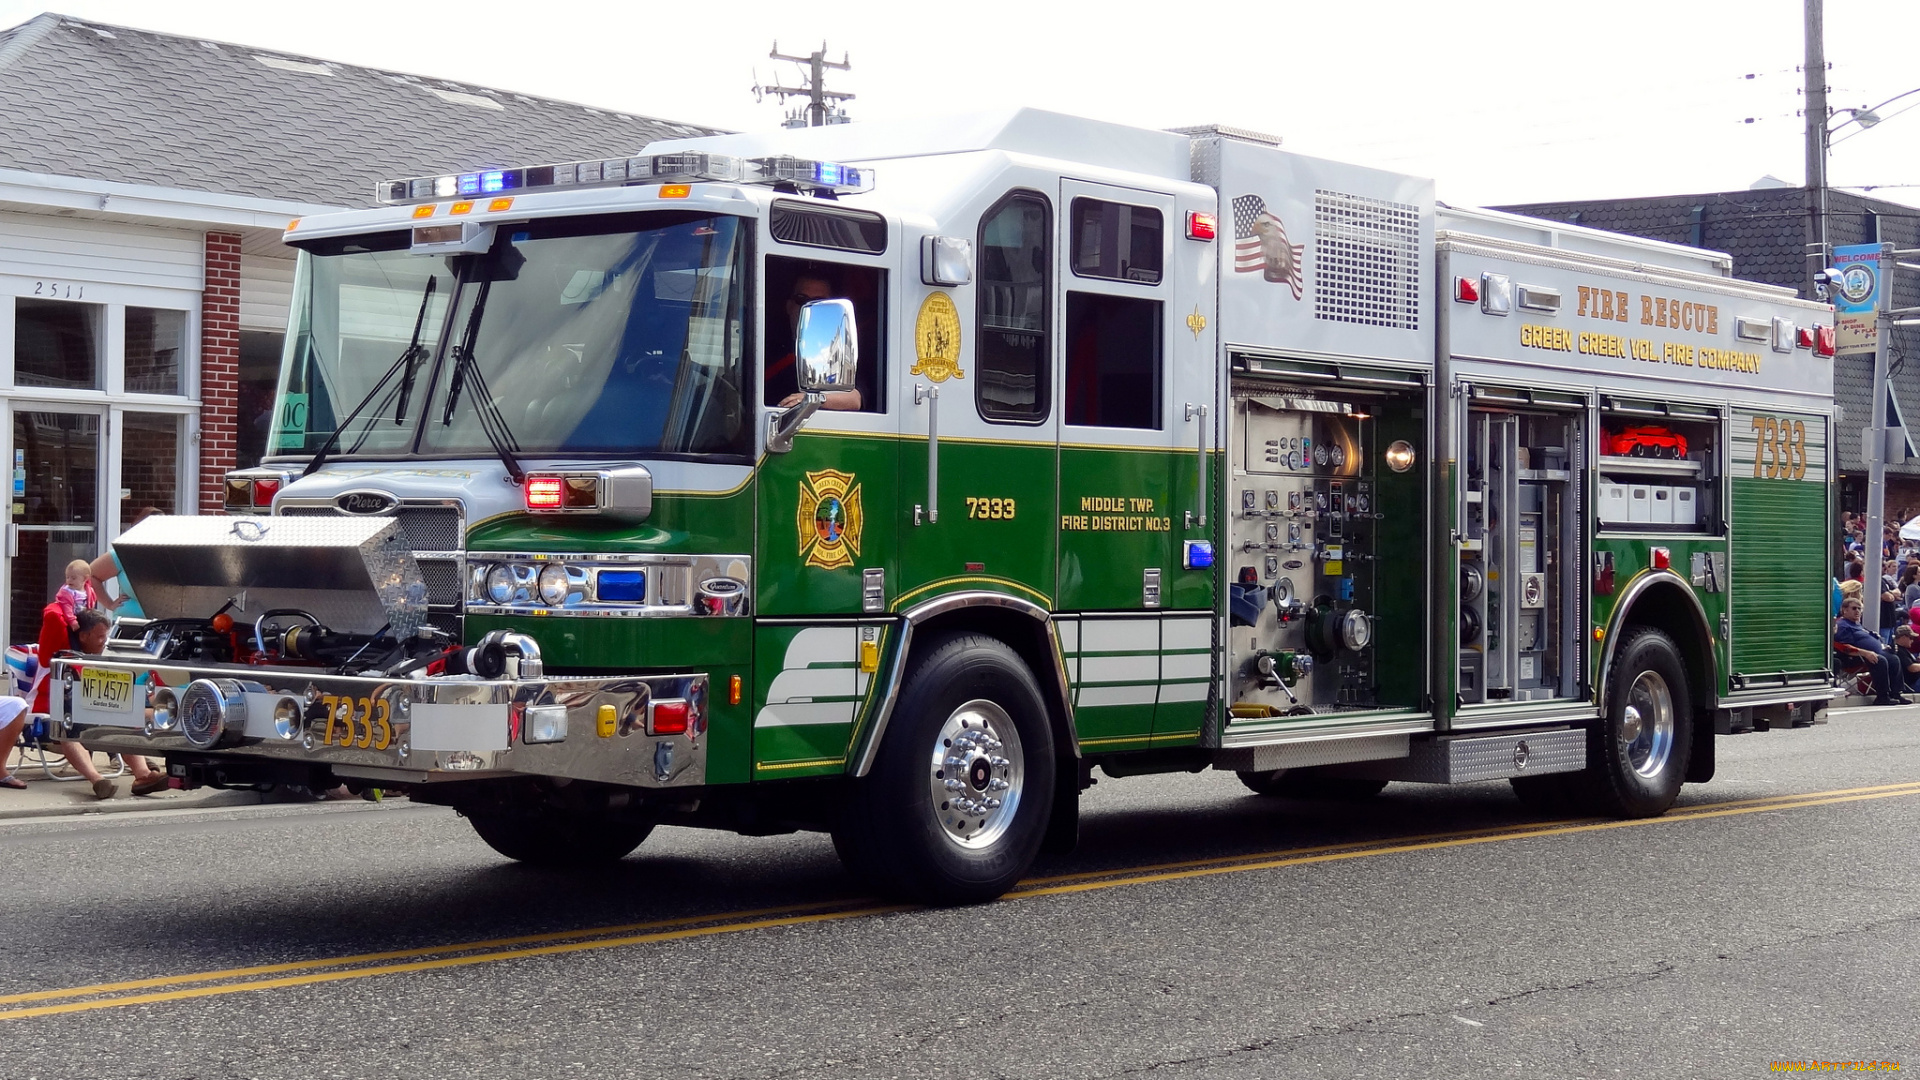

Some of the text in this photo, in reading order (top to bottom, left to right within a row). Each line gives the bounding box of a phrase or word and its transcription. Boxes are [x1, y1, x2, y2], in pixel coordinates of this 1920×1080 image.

[1834, 252, 1882, 263] WELCOME
[34, 281, 83, 299] 2511
[1577, 285, 1718, 334] FIRE RESCUE
[1520, 324, 1762, 374] GREEN CREEK VOL. FIRE COMPANY
[1751, 416, 1807, 479] 7333
[346, 494, 382, 511] Pierce
[965, 497, 1015, 519] 7333
[1081, 497, 1154, 513] MIDDLE TWP.
[1061, 515, 1088, 531] FIRE
[1092, 516, 1143, 531] DISTRICT
[83, 678, 129, 702] NF14577
[322, 695, 392, 750] 7333
